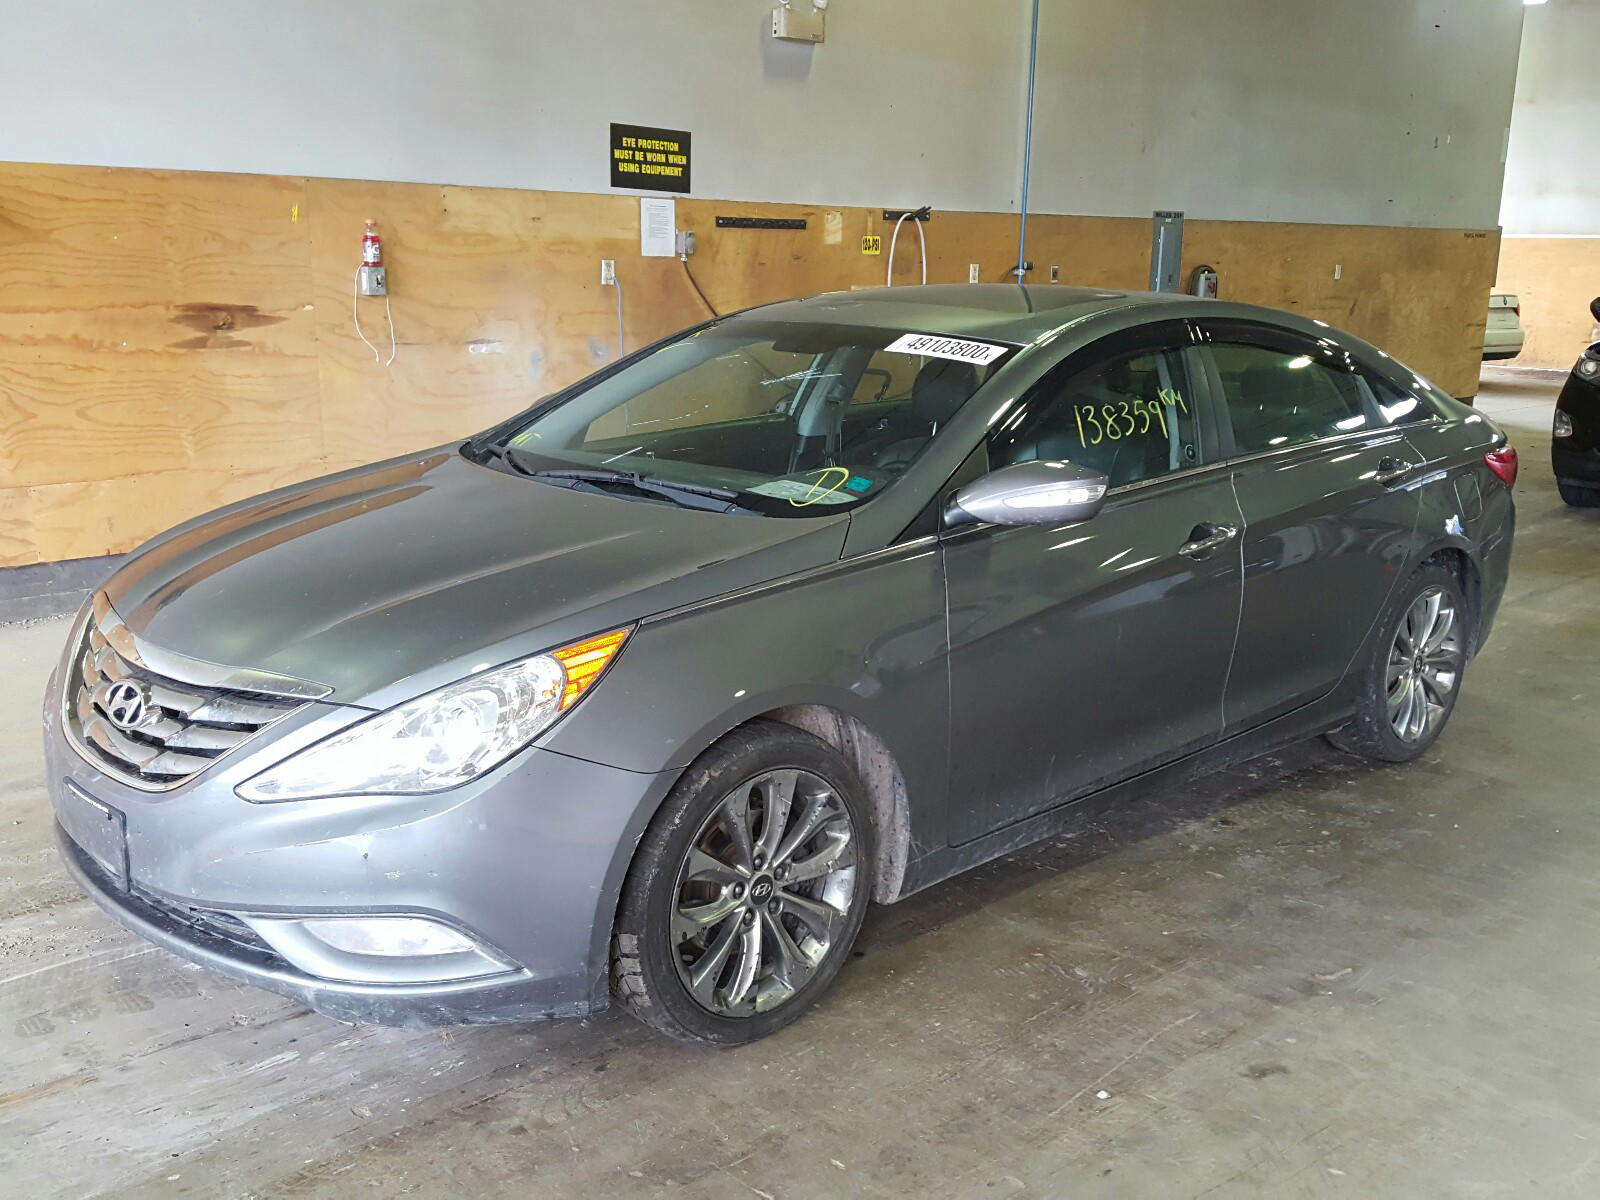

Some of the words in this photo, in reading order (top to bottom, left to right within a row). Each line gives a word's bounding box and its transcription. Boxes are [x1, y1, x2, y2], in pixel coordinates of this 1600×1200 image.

[623, 137, 636, 147] EYE
[638, 139, 679, 151] PROTECTION
[614, 149, 633, 160] MUST
[635, 151, 644, 161] BE
[646, 152, 666, 163] WORN
[668, 154, 687, 165] WHEN
[619, 162, 640, 173] USING
[642, 164, 683, 176] EQUIPEMENT
[1074, 400, 1168, 449] 138359
